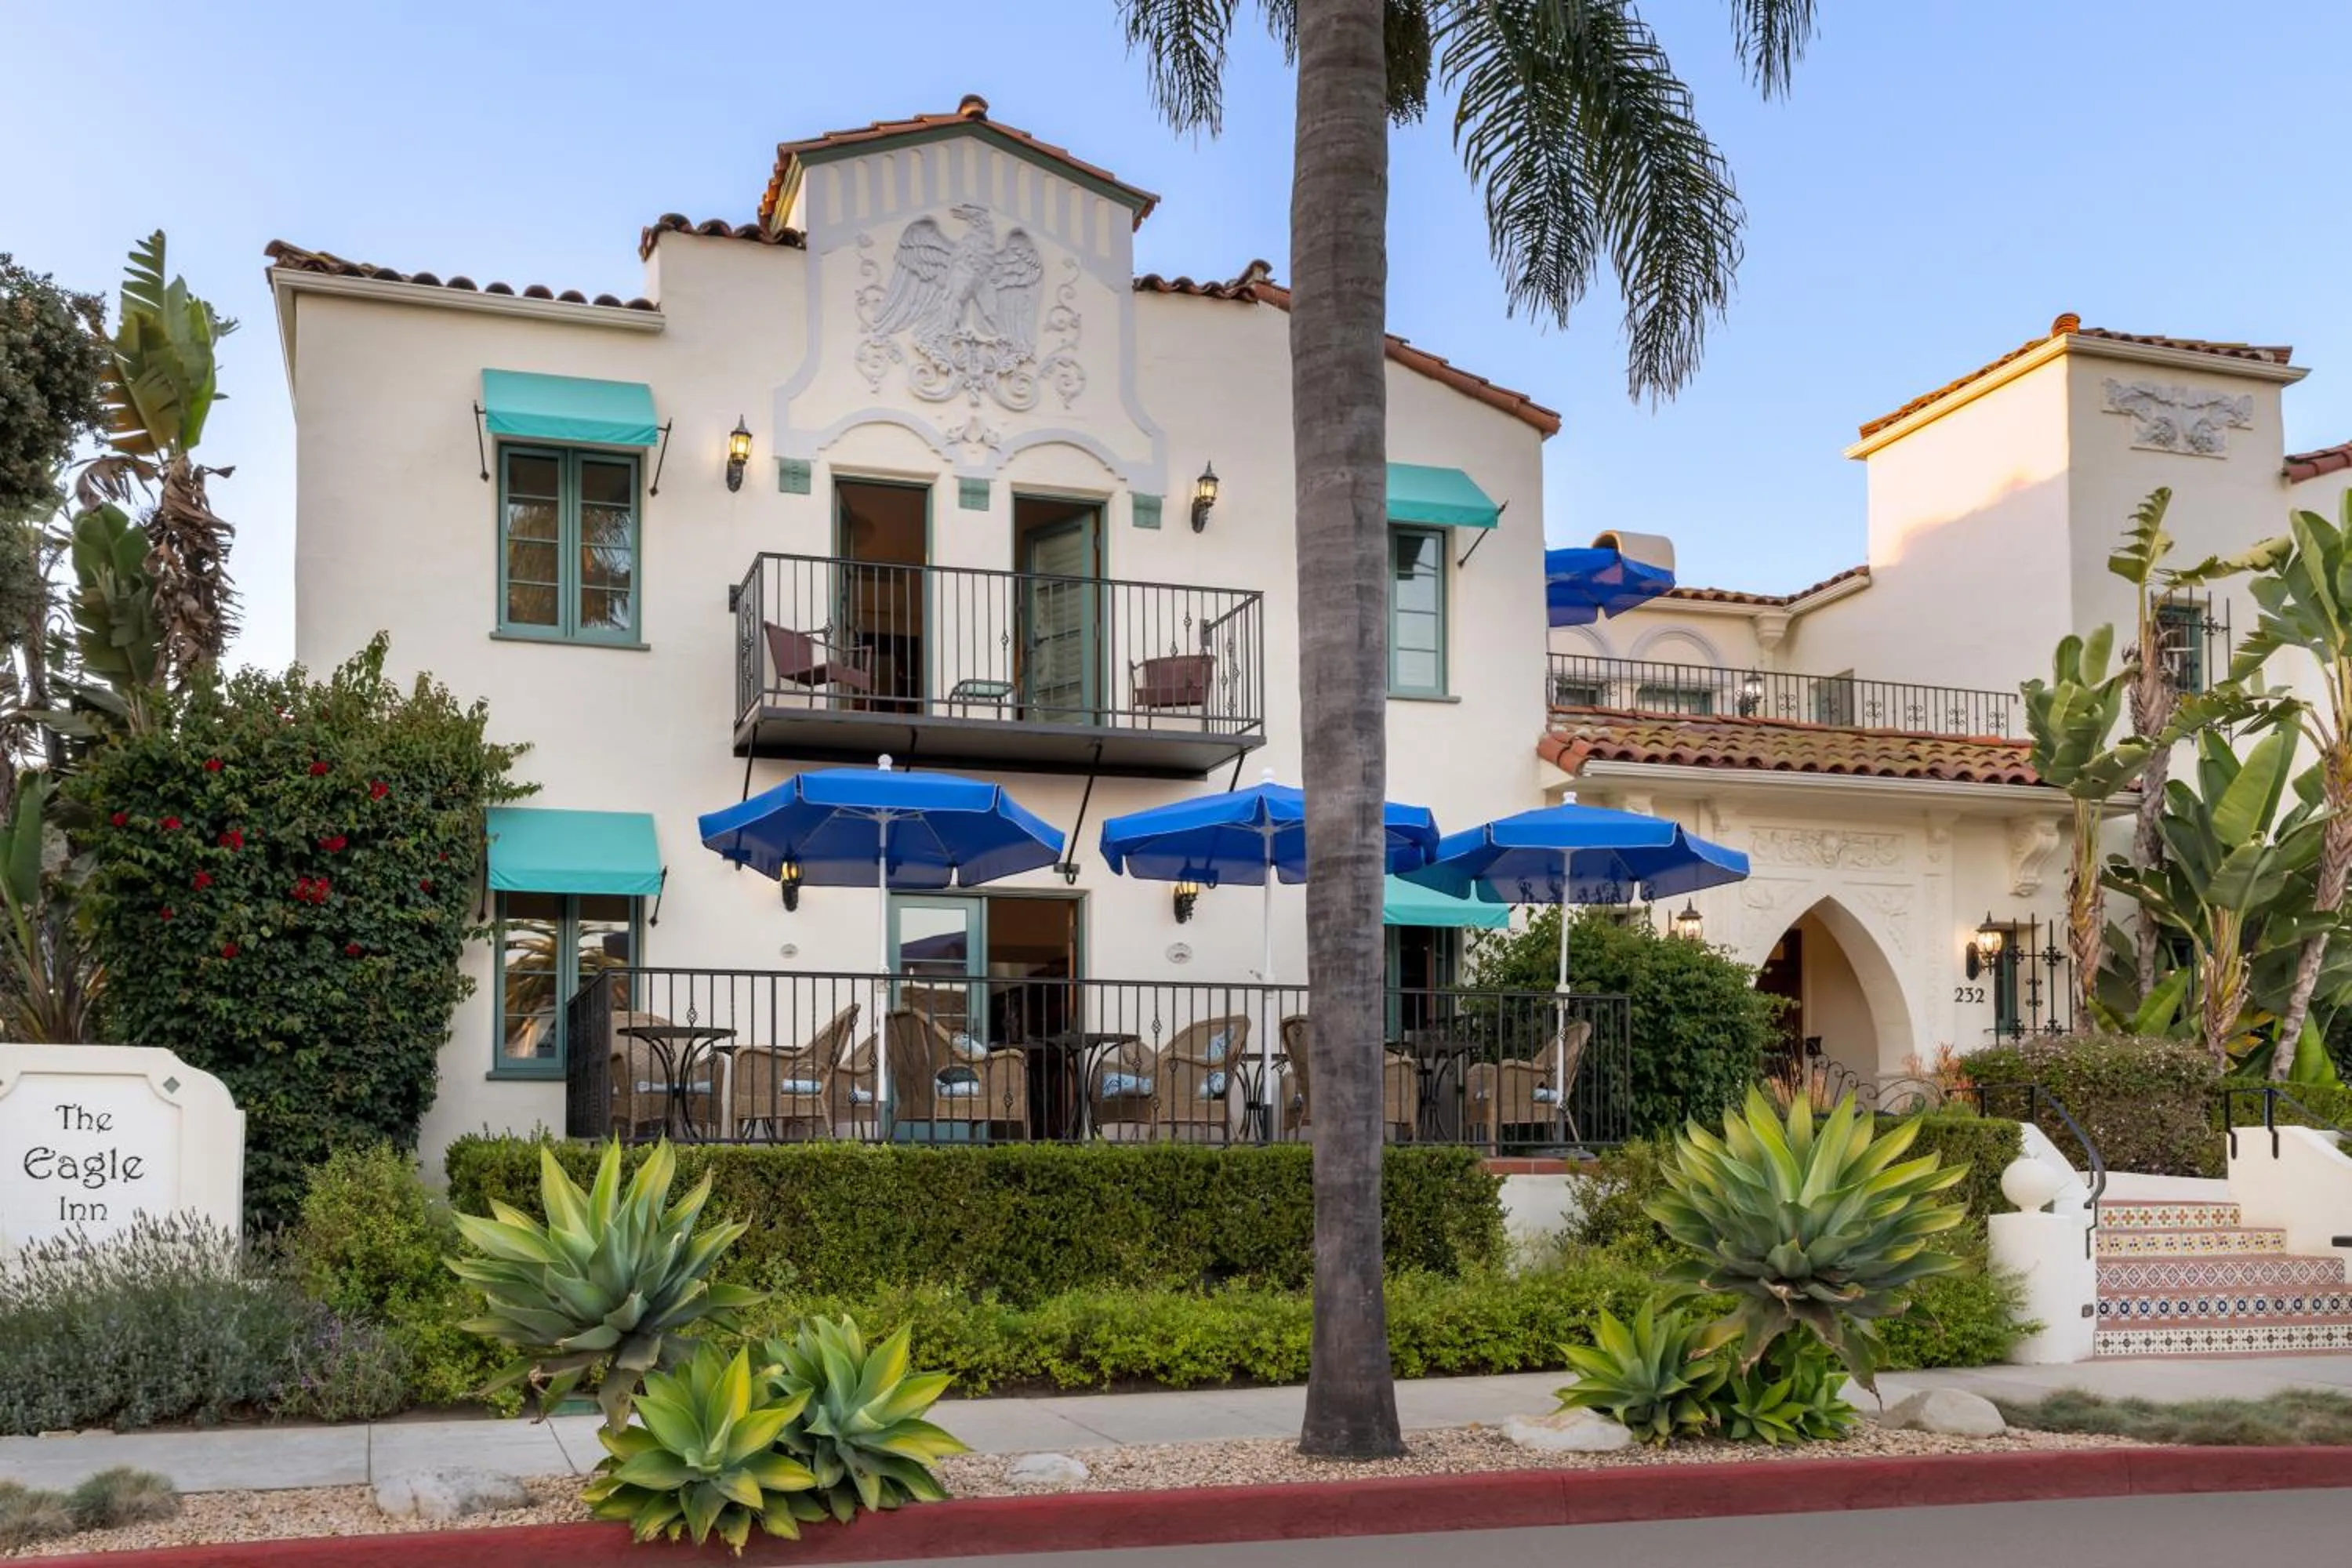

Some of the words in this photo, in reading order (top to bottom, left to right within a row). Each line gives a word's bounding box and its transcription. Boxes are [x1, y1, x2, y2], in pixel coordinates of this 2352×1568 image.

[1955, 986, 1985, 1004] 232
[54, 1103, 113, 1134] The
[24, 1146, 145, 1189] Eagle
[59, 1196, 107, 1221] Inn
